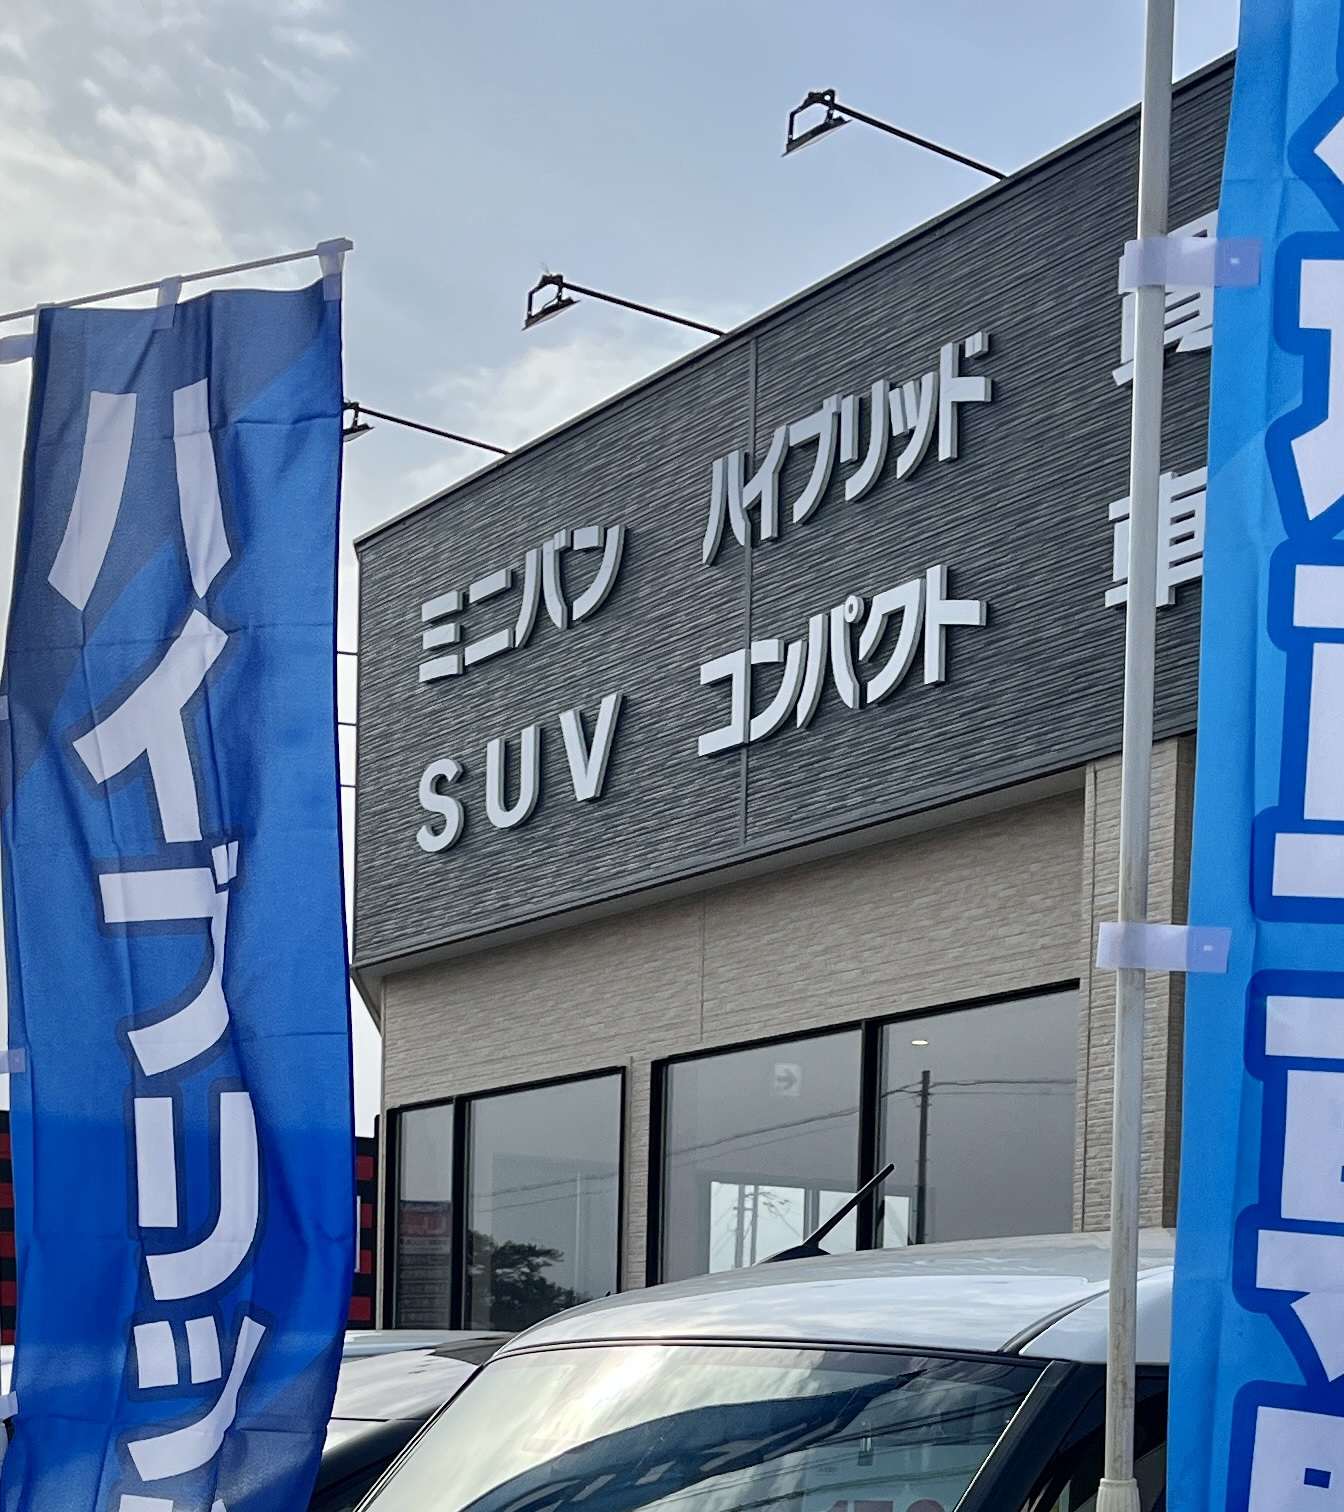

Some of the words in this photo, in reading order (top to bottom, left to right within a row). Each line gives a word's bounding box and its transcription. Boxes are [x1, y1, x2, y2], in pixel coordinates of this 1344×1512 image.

[701, 331, 992, 566] ハイブリッド
[418, 522, 628, 685] ミニバン
[697, 563, 988, 759] コンパクト
[416, 692, 624, 854] SUV
